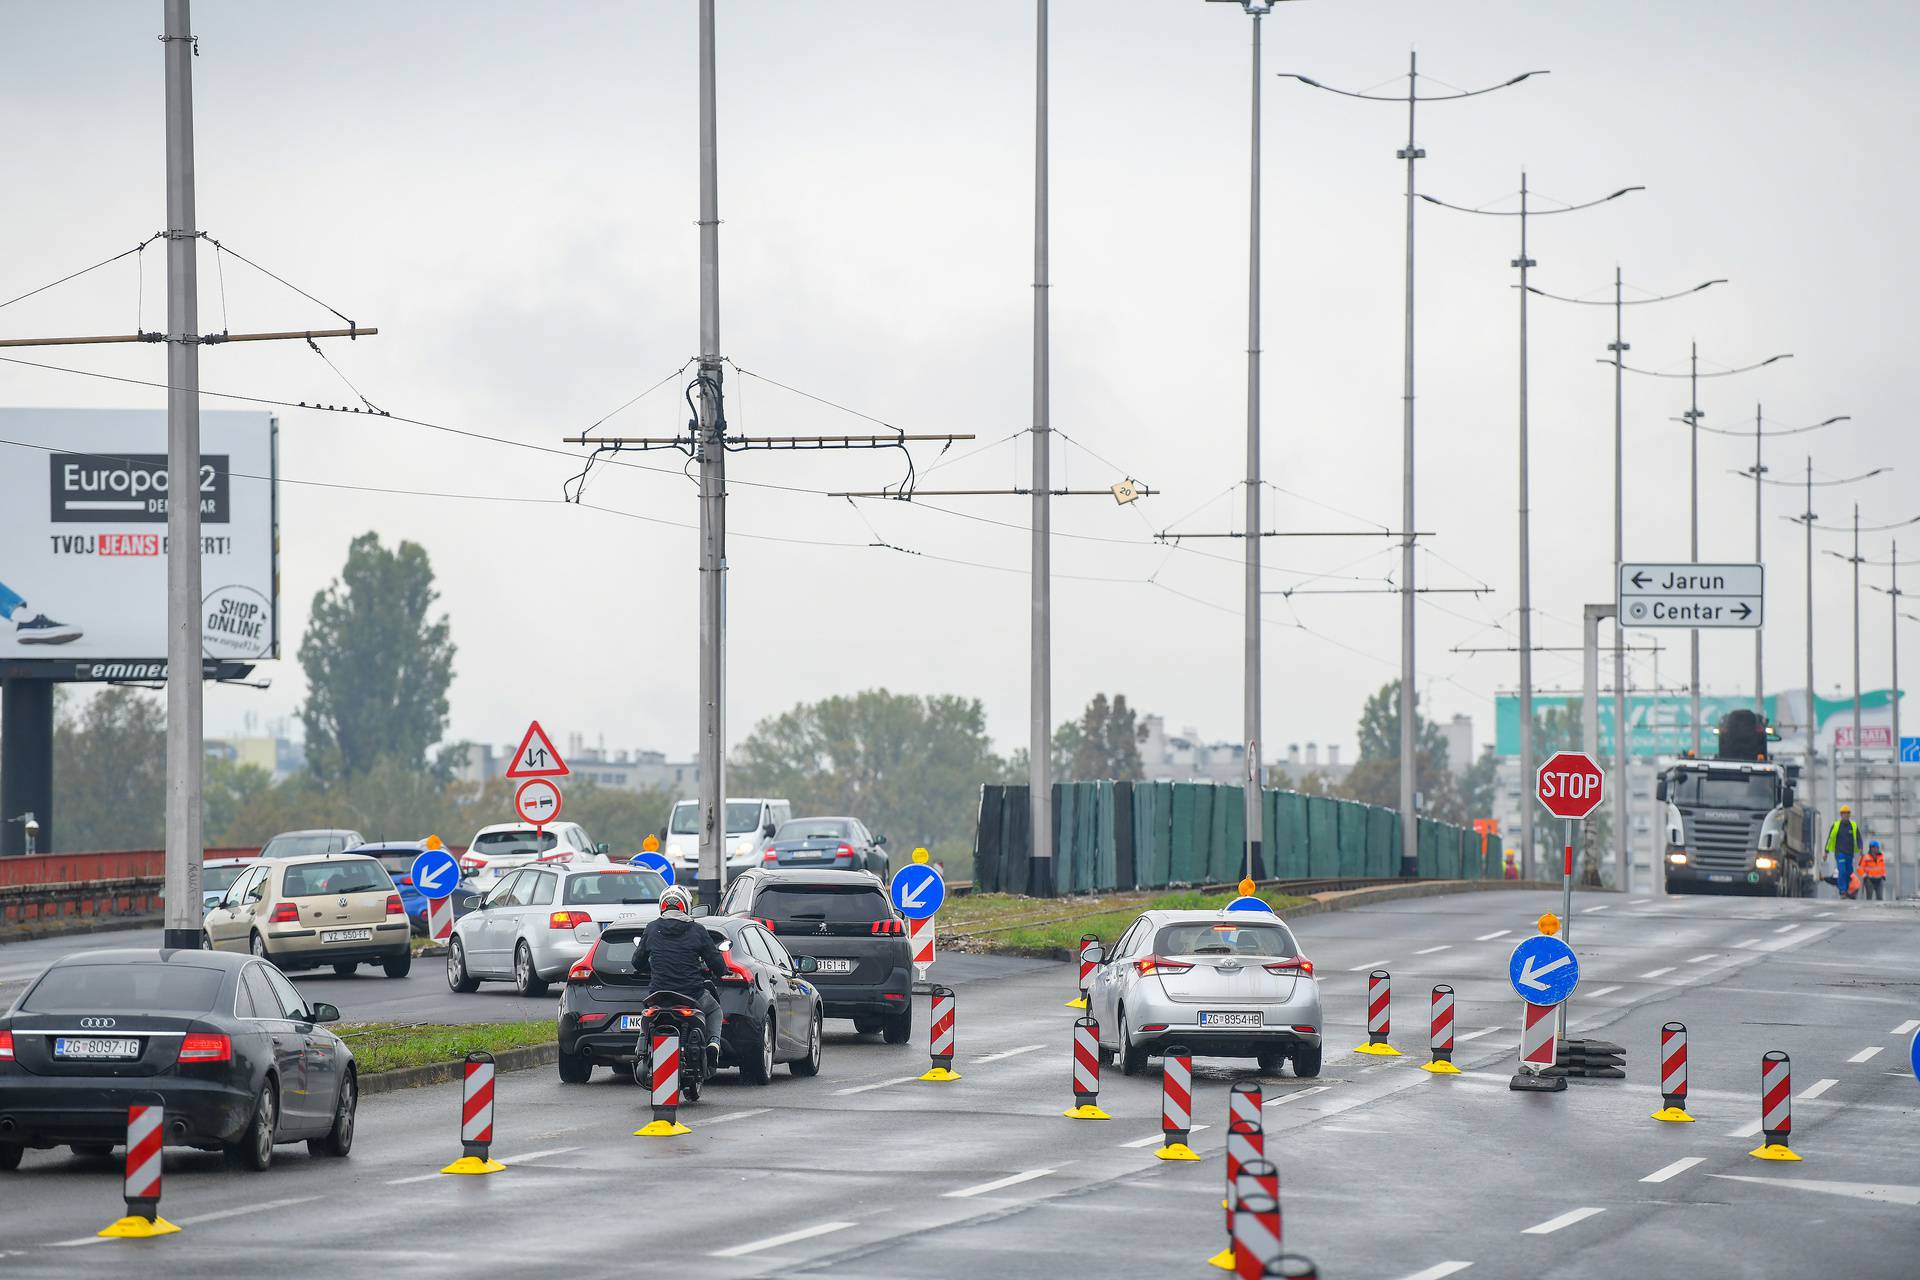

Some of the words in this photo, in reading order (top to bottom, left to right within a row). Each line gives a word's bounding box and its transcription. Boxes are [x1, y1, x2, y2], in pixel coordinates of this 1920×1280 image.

[1120, 487, 1131, 496] 20
[51, 535, 95, 554] TVOJ
[101, 535, 157, 555] JEANS
[1662, 572, 1724, 590] Jarun
[219, 598, 259, 619] SHOP
[1653, 602, 1723, 620] Centar
[207, 612, 264, 640] ONLINE
[1542, 771, 1599, 799] STOP
[328, 932, 338, 941] VZ
[1207, 1014, 1219, 1024] ZG
[65, 1040, 80, 1053] ZG
